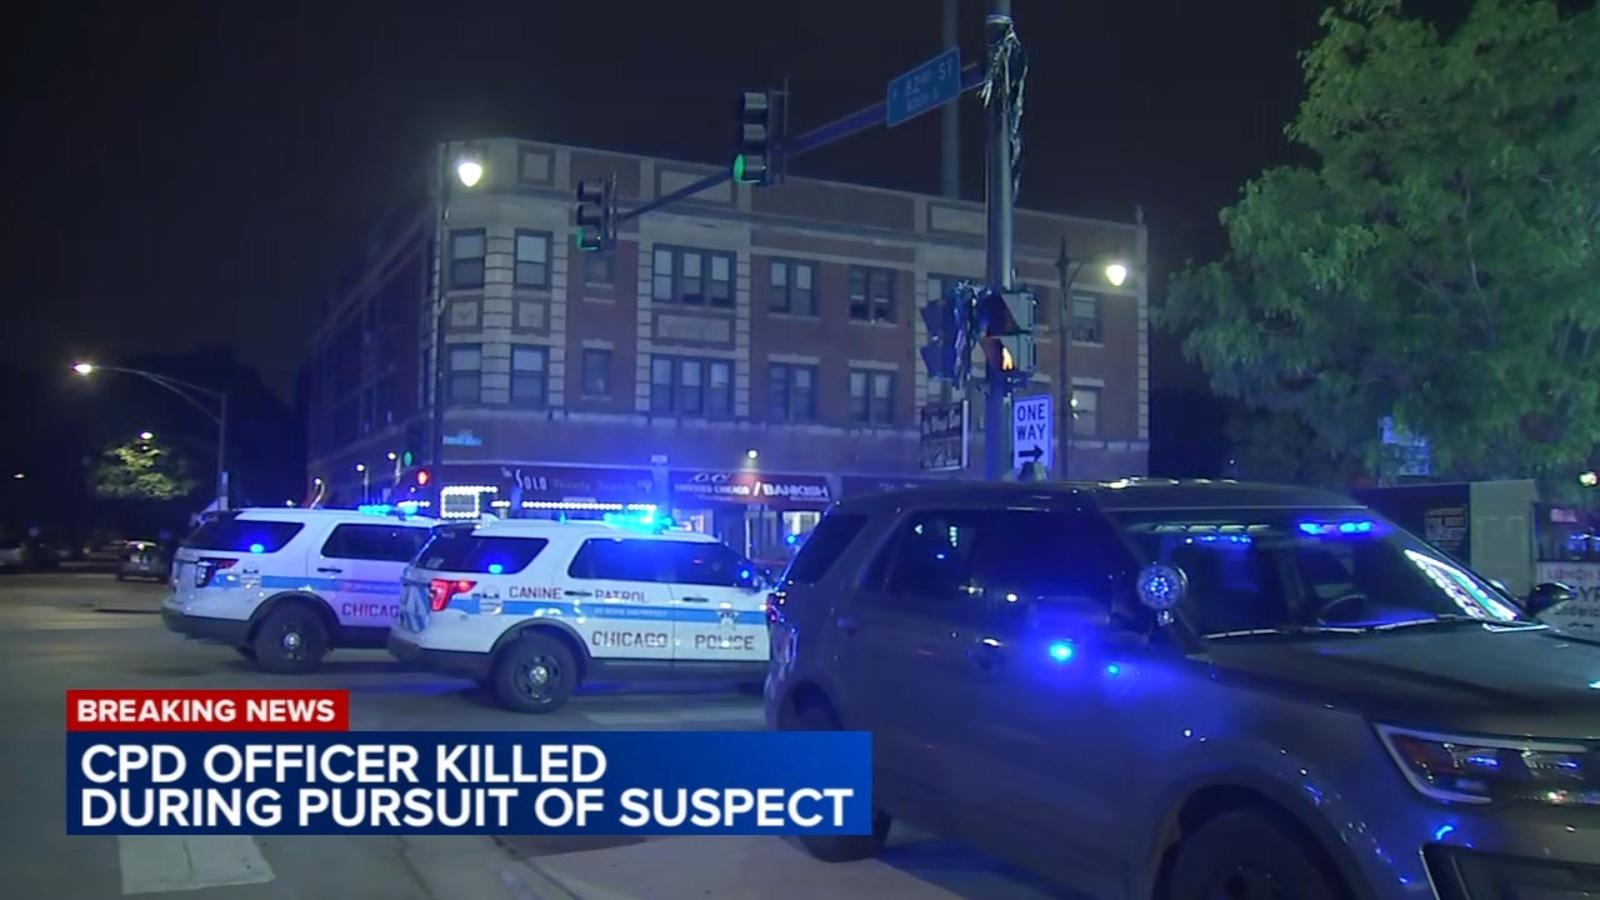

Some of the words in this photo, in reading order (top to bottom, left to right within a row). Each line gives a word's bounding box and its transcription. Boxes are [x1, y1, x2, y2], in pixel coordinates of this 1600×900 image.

[1016, 403, 1045, 421] ONE
[1016, 424, 1046, 440] WAY
[508, 586, 562, 600] CANINE
[595, 588, 645, 604] PATROL
[341, 602, 401, 619] CHICAG
[592, 630, 668, 649] CHICAGO
[695, 634, 755, 650] POLICE
